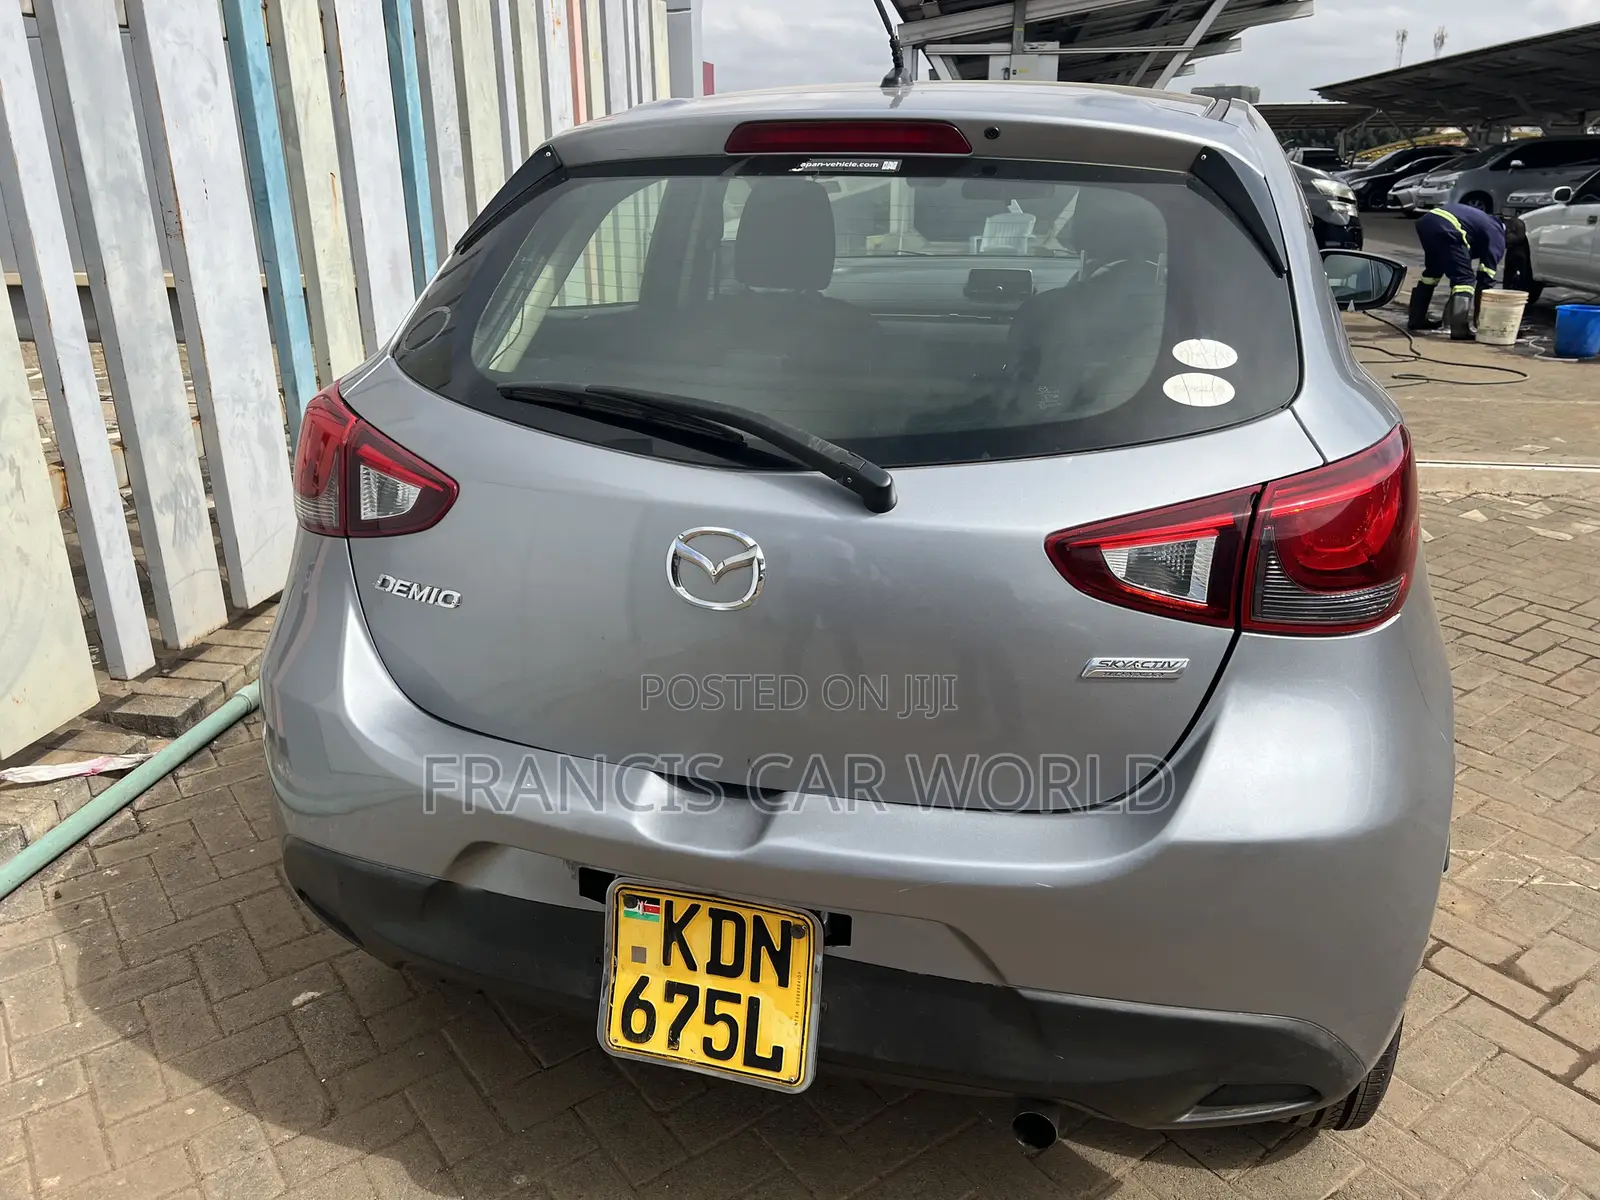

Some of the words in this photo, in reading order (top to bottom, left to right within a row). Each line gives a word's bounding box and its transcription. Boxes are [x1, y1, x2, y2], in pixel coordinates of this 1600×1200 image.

[794, 161, 879, 170] apan-vehicle.com
[373, 573, 462, 608] DEMIO
[1097, 660, 1180, 669] SKYACTIV
[662, 900, 793, 989] KDN
[621, 975, 785, 1073] 675L
